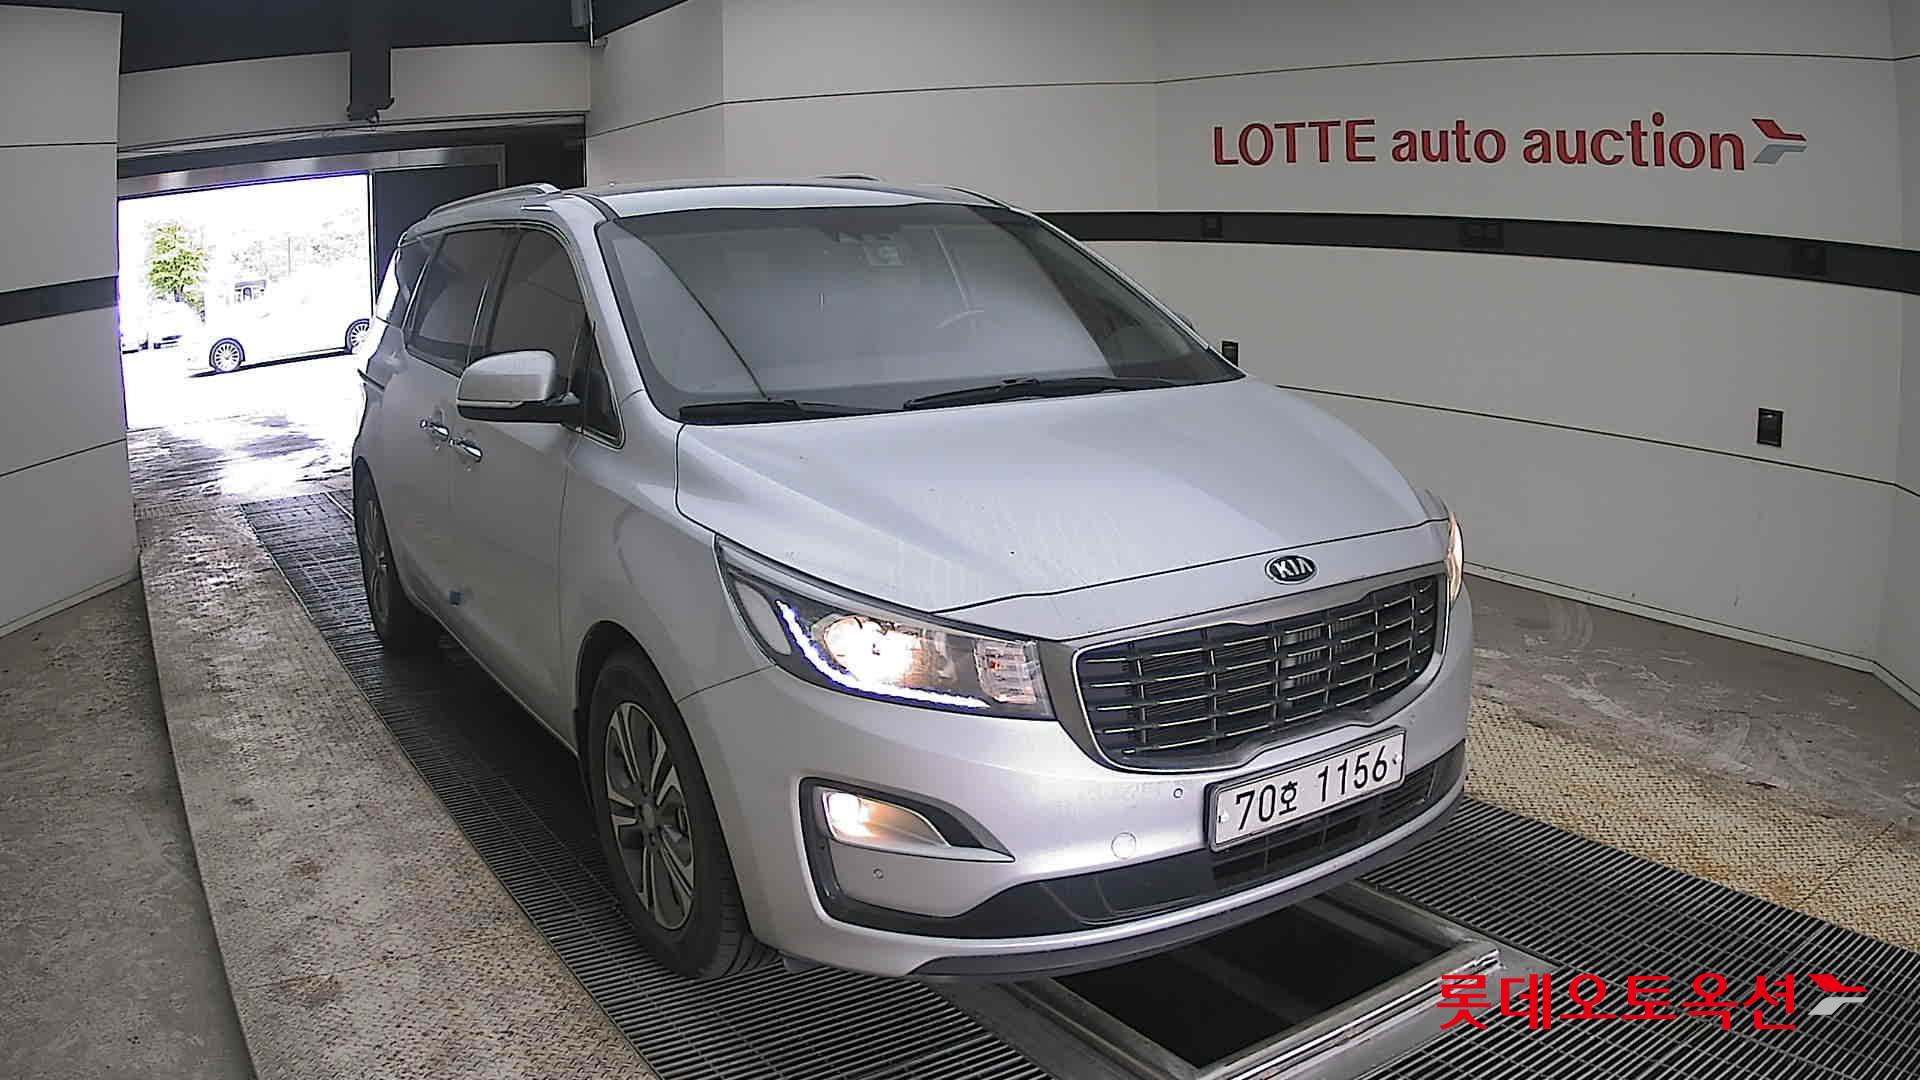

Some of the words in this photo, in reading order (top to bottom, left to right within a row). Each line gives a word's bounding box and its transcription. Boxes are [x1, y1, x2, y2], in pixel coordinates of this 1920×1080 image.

[1213, 119, 1376, 166] LOTTE
[1391, 119, 1507, 164] auto
[1522, 112, 1746, 171] auction
[1272, 557, 1314, 578] KIA
[1235, 780, 1299, 831] 70호
[1317, 745, 1389, 802] 1156
